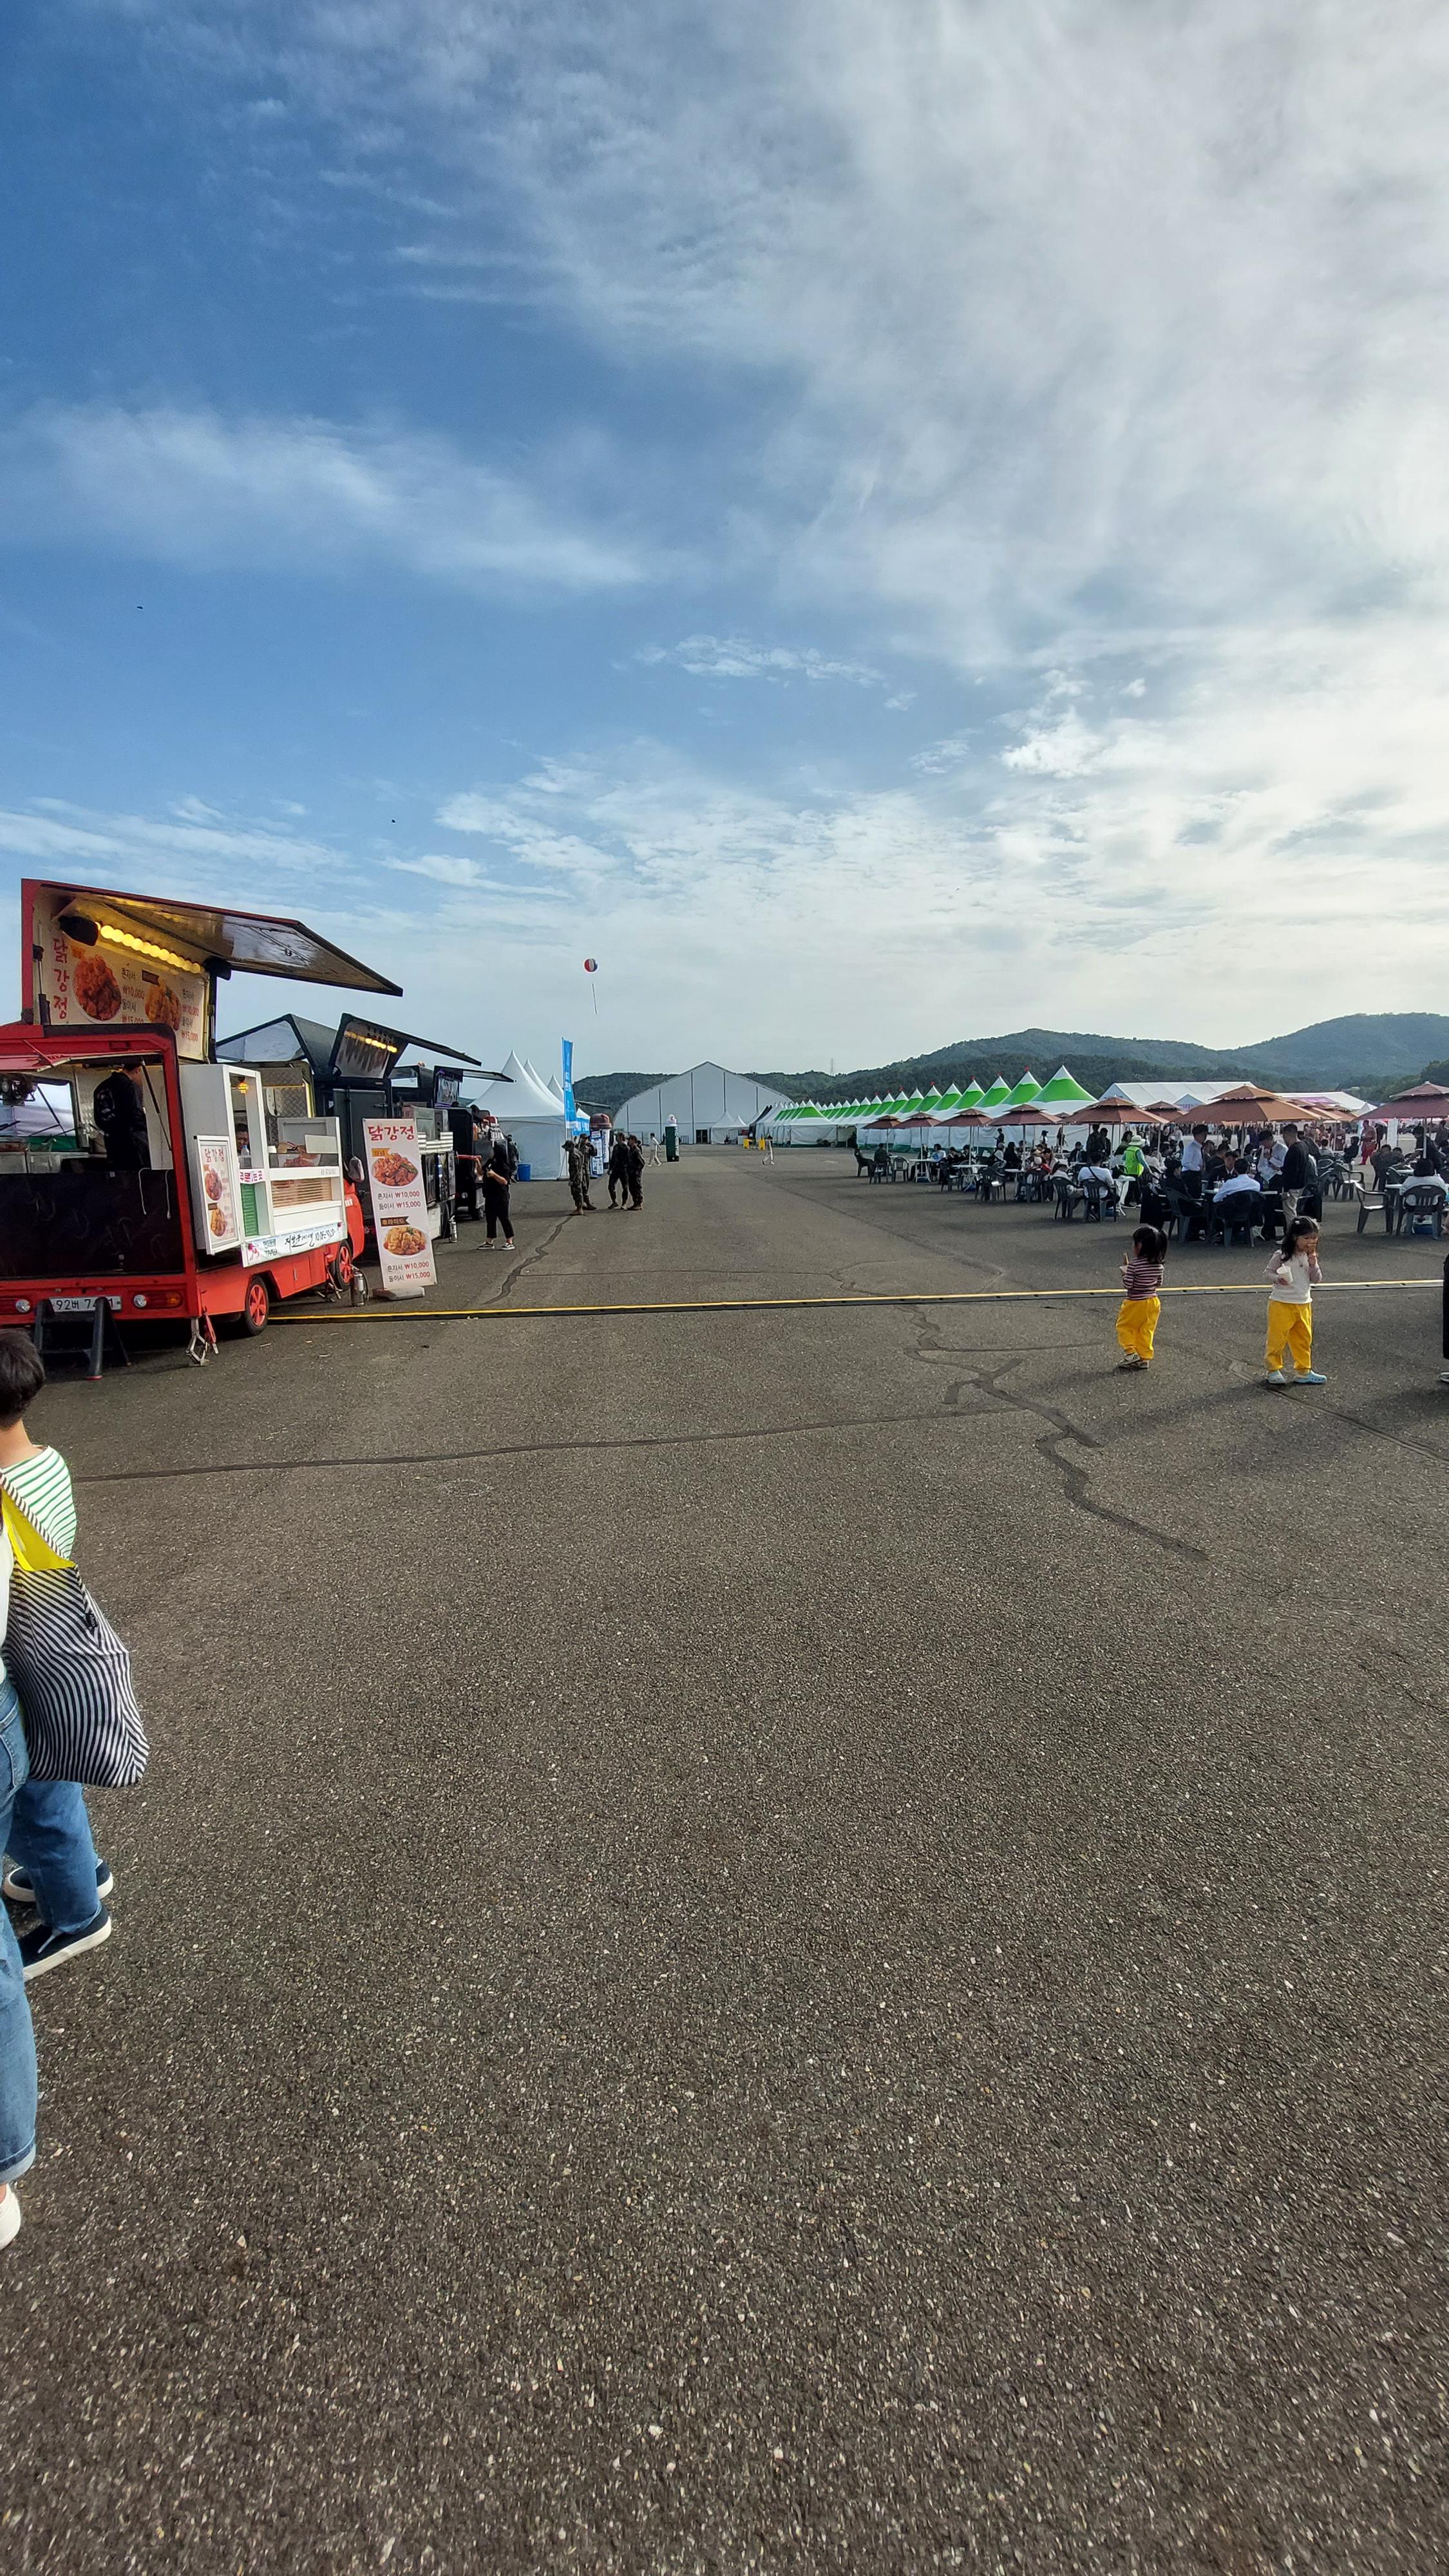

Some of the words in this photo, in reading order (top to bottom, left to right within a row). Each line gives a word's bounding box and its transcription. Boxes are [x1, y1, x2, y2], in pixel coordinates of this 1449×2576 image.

[53, 938, 70, 1019] 닭강정
[368, 1126, 414, 1141] 닭강정
[404, 1262, 430, 1270] ₩10,000
[406, 1272, 431, 1280] ₩15,000
[56, 1300, 79, 1310] 92버
